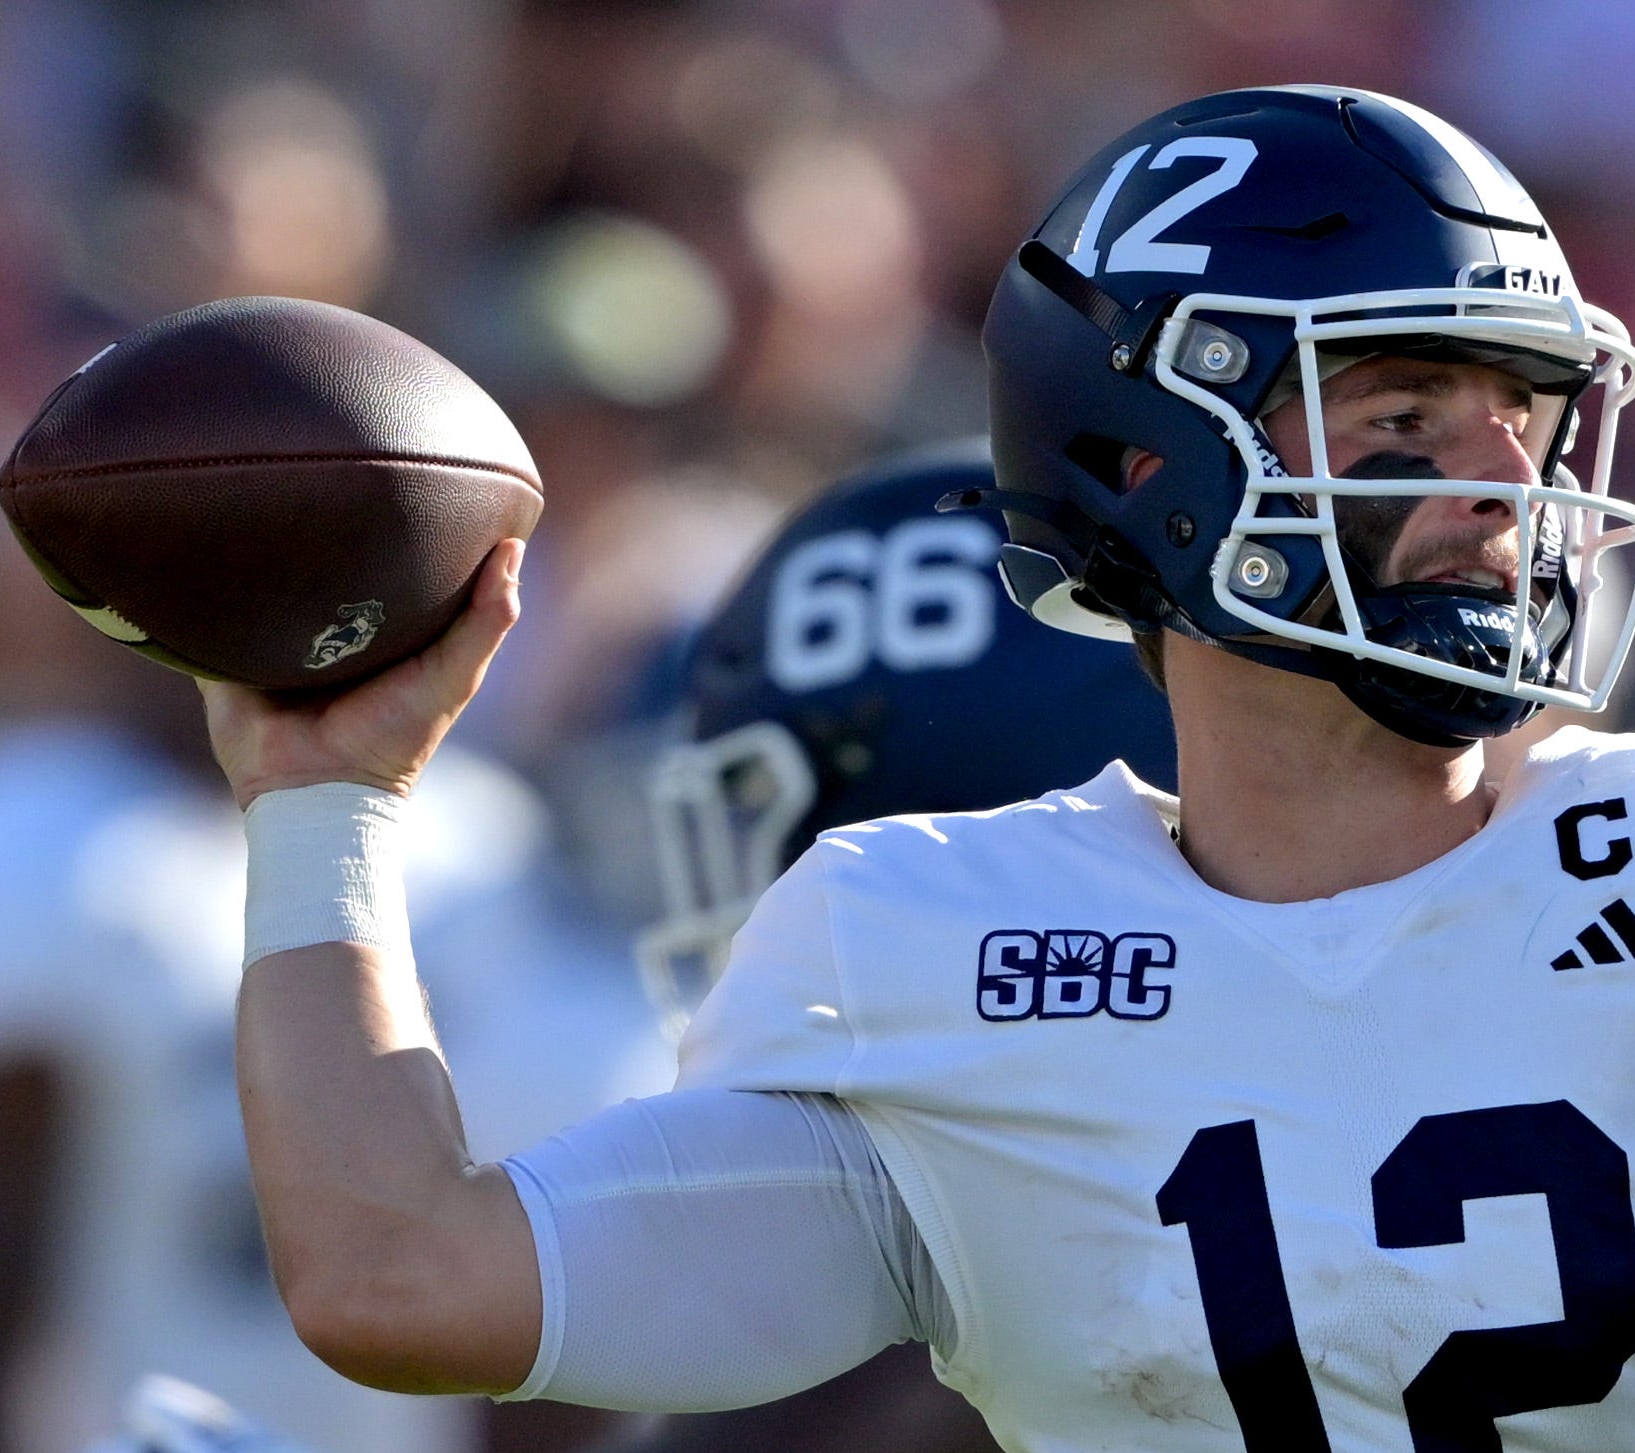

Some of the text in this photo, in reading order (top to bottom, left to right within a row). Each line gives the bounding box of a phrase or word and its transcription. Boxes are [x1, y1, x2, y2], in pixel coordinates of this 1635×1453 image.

[1067, 136, 1259, 278] 12
[769, 514, 1003, 693] 66
[1554, 797, 1633, 881] C
[976, 929, 1177, 1022] SBC
